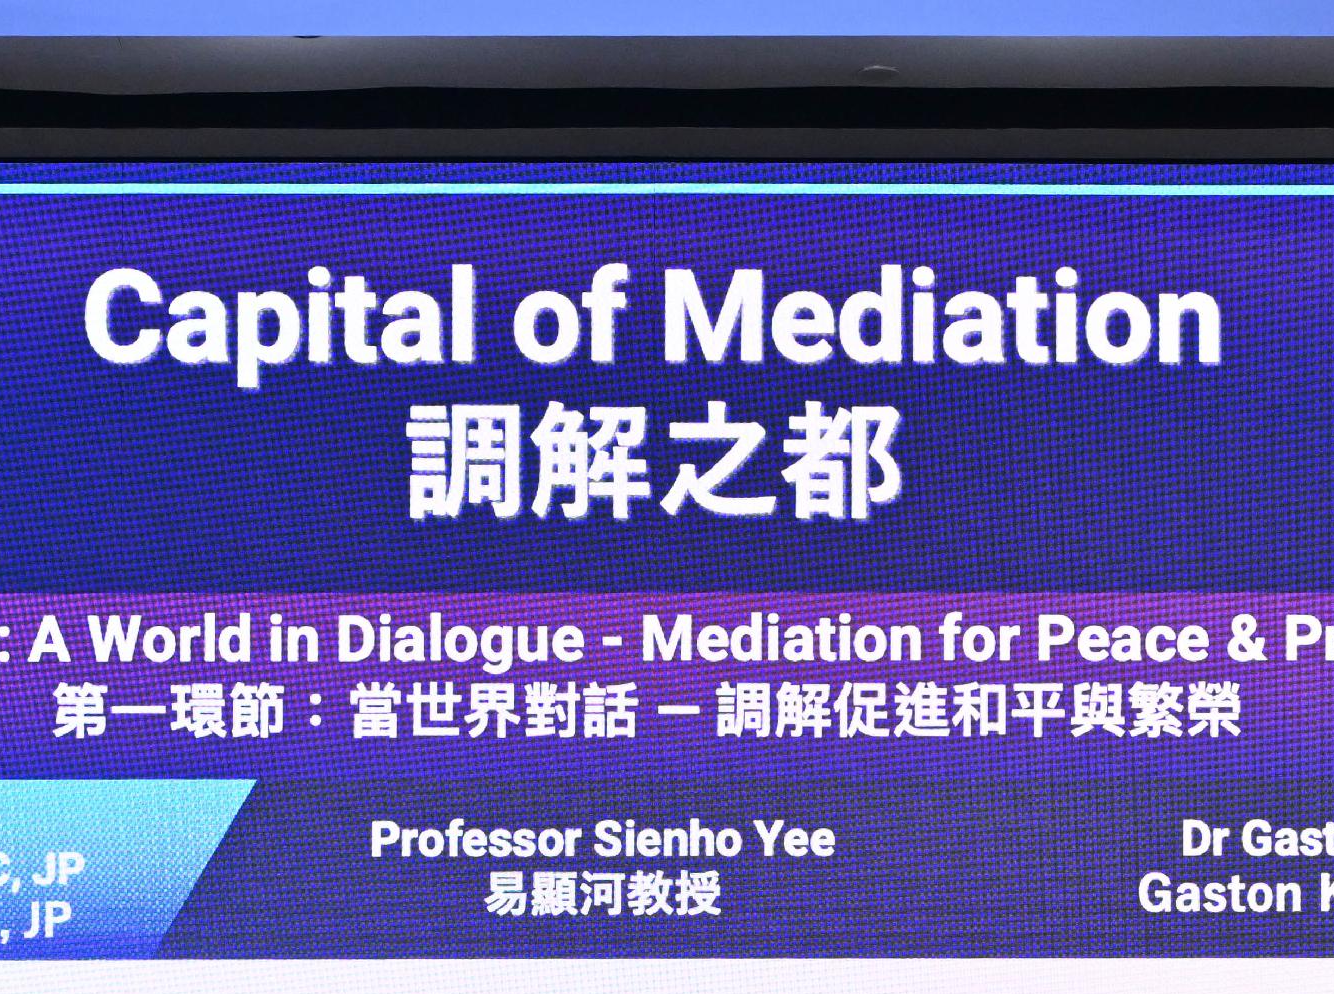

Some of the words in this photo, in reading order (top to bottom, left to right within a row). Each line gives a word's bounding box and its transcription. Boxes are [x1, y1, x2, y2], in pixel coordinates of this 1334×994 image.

[84, 264, 474, 389] Capital
[513, 262, 629, 364] of
[664, 264, 1220, 365] Mediation
[405, 400, 901, 520] 調解之都
[27, 615, 71, 662] A
[87, 612, 251, 663] World
[270, 613, 319, 662] in
[338, 612, 585, 675] Dialogue
[642, 612, 922, 662] Mediation
[938, 611, 1021, 662] for
[1038, 614, 1209, 662] Peace
[1227, 613, 1267, 662] &
[716, 681, 1241, 739] 調解促進和平與繁榮
[371, 818, 583, 858] Professor
[594, 818, 743, 857] Sienho
[753, 819, 836, 857] Yee
[1182, 819, 1230, 856] Dr
[32, 851, 85, 886] JP
[484, 869, 722, 916] 易顯河教授
[1138, 872, 1302, 913] Gaston
[23, 900, 72, 939] JP
